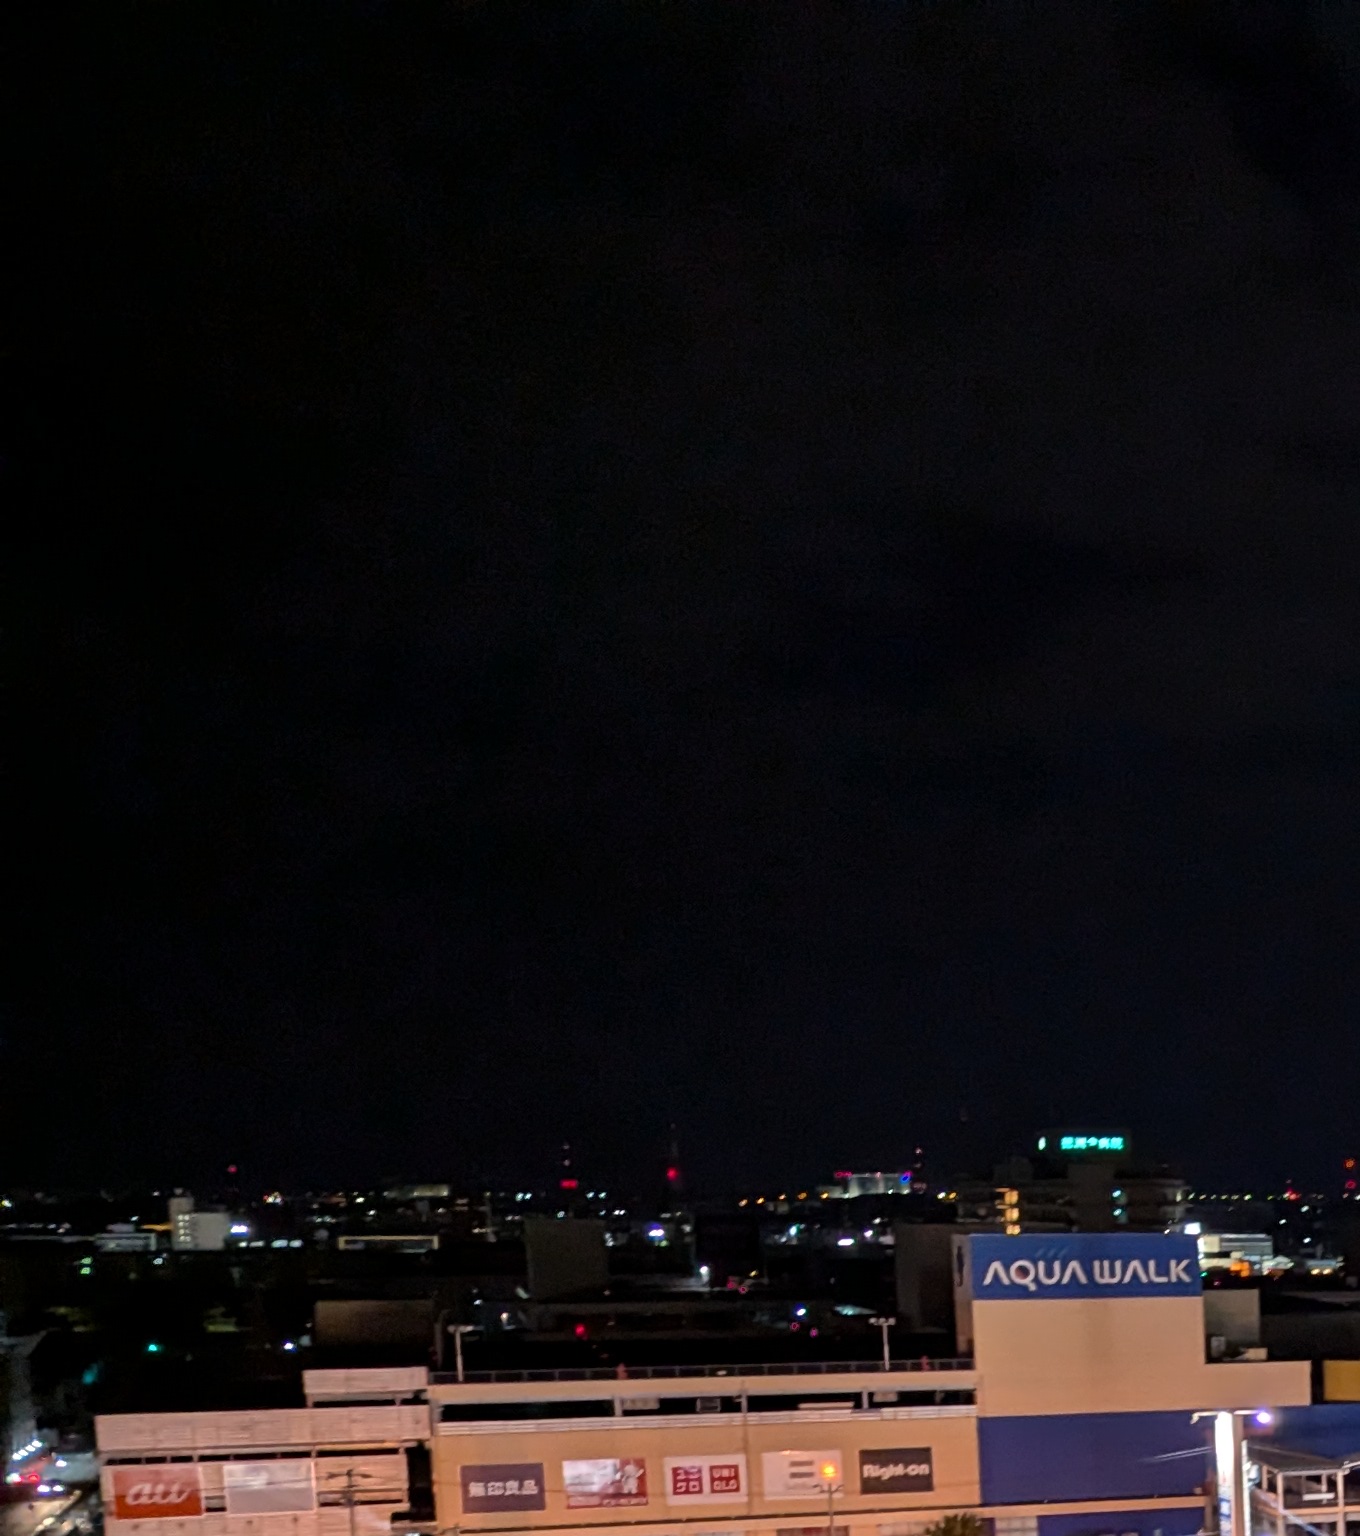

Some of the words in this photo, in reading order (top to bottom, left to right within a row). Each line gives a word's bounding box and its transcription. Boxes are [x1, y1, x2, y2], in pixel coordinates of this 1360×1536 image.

[983, 1259, 1088, 1292] AQUA
[1093, 1258, 1192, 1284] WALK
[862, 1463, 930, 1481] Right-on
[126, 1481, 192, 1505] au
